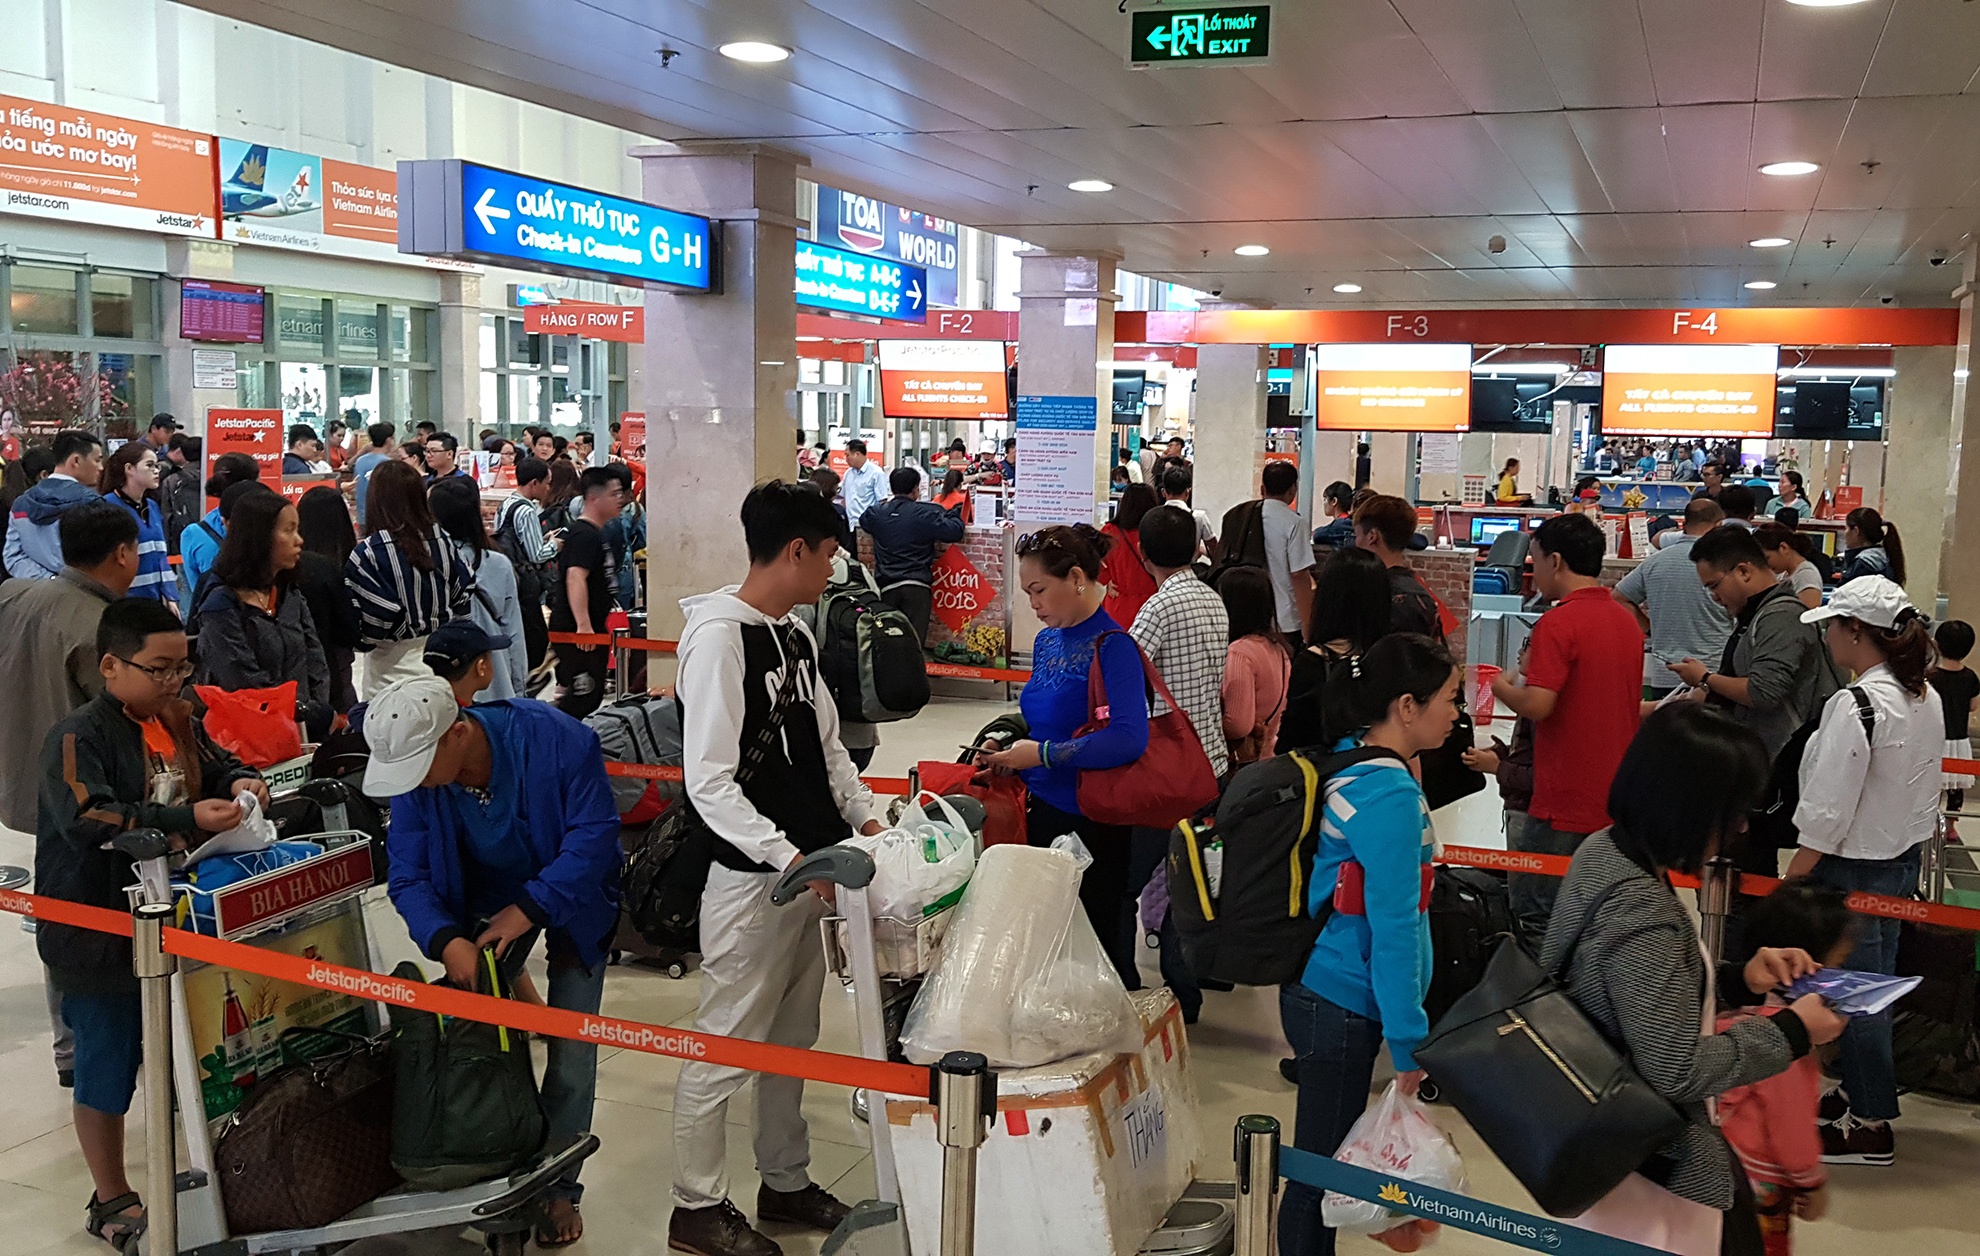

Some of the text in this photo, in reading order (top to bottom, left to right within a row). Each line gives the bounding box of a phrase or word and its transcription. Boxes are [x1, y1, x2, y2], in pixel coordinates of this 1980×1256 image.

[1204, 13, 1257, 31] LỐI THOÁT
[1208, 39, 1251, 55] EXIT
[9, 107, 55, 136] tiếng
[60, 116, 92, 139] mỗi
[96, 127, 138, 150] ngày
[31, 137, 65, 158] ước
[69, 145, 99, 164] mơ
[101, 149, 137, 172] bay!
[7, 191, 70, 211] jetstar.com
[100, 187, 138, 199] jetstar.com
[331, 181, 356, 196] Thỏa
[357, 186, 375, 199] sức
[376, 189, 391, 204] lựa
[332, 198, 398, 219] Vietnam Airlin
[570, 200, 604, 230] THỦ
[607, 209, 640, 237] TỤC
[842, 191, 881, 232] TOA
[156, 213, 193, 229] Jetstar
[899, 207, 956, 234] CLOR
[583, 236, 643, 265] Counters
[899, 231, 956, 270] WORLD
[338, 321, 376, 339] irlines
[540, 311, 577, 327] HÀNG
[587, 313, 618, 327] ROW
[622, 311, 634, 329] F
[940, 313, 974, 334] F-2
[1387, 315, 1429, 337] F-3
[1673, 312, 1718, 335] F-4
[902, 394, 988, 404] ALL FLIGHTS CHECK-IN
[1618, 403, 1758, 414] ALL FLIGHTS CHECK-IN
[214, 418, 276, 429] JetstarPacific
[932, 565, 979, 590] Xuân
[933, 589, 978, 611] 2018
[926, 664, 981, 678] JetstarPacific
[1441, 849, 1543, 870] etstarPacific
[249, 884, 287, 917] BIA
[287, 870, 317, 903] HÀ
[1847, 896, 1929, 918] arPacific
[306, 963, 416, 1003] JetstarPacific
[578, 1017, 706, 1057] JetstarPacific
[1124, 1092, 1164, 1169] THẮNG
[1409, 1192, 1475, 1223] Vietnam
[1475, 1211, 1537, 1239] Airlines
